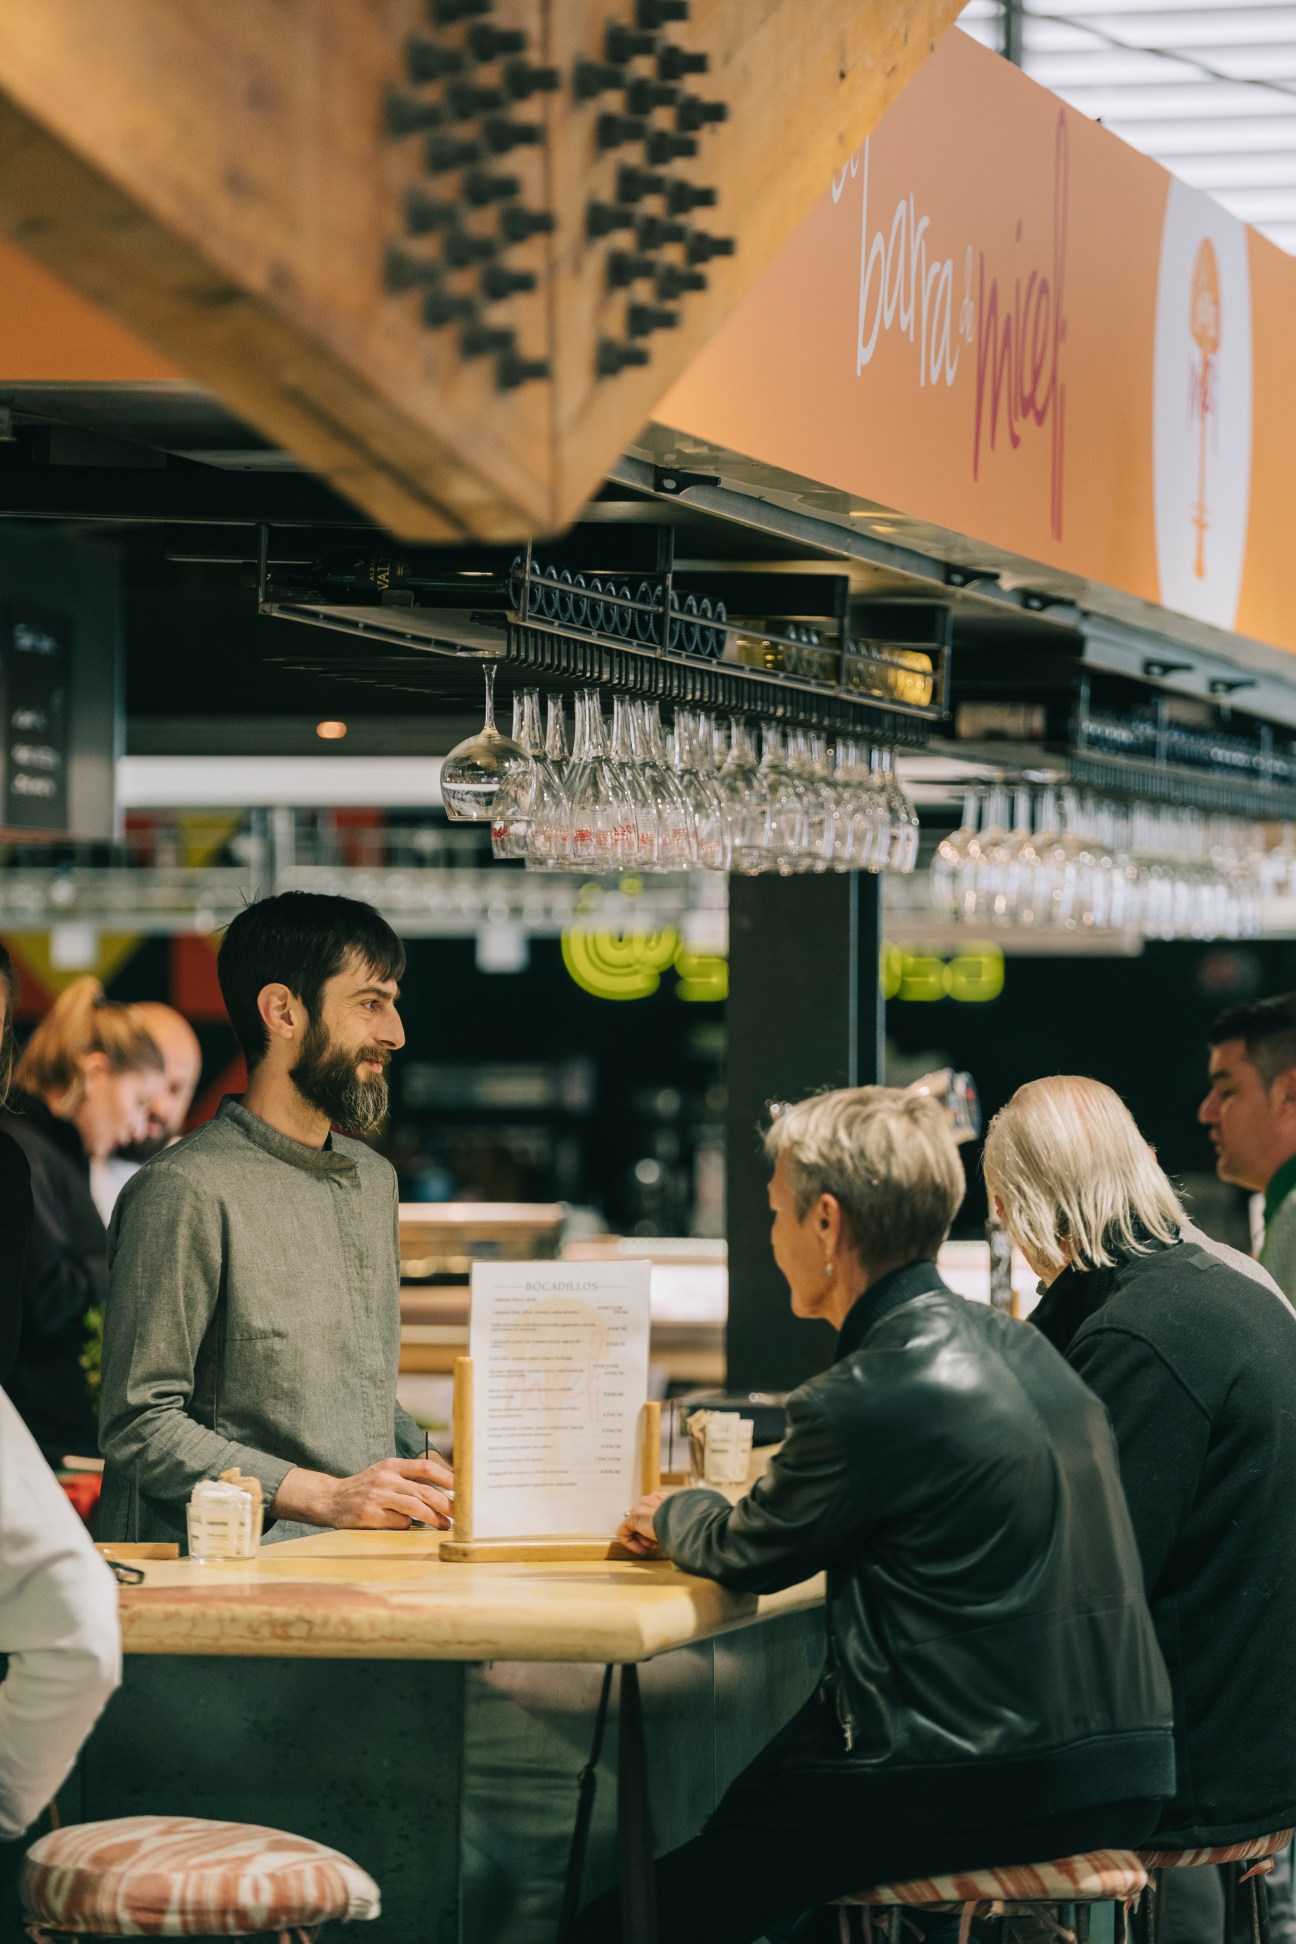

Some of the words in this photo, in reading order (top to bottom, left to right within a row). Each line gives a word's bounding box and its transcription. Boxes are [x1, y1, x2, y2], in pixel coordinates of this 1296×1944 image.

[857, 134, 960, 388] barra
[973, 106, 1069, 543] miel
[525, 1281, 599, 1292] BOCADILLOS
